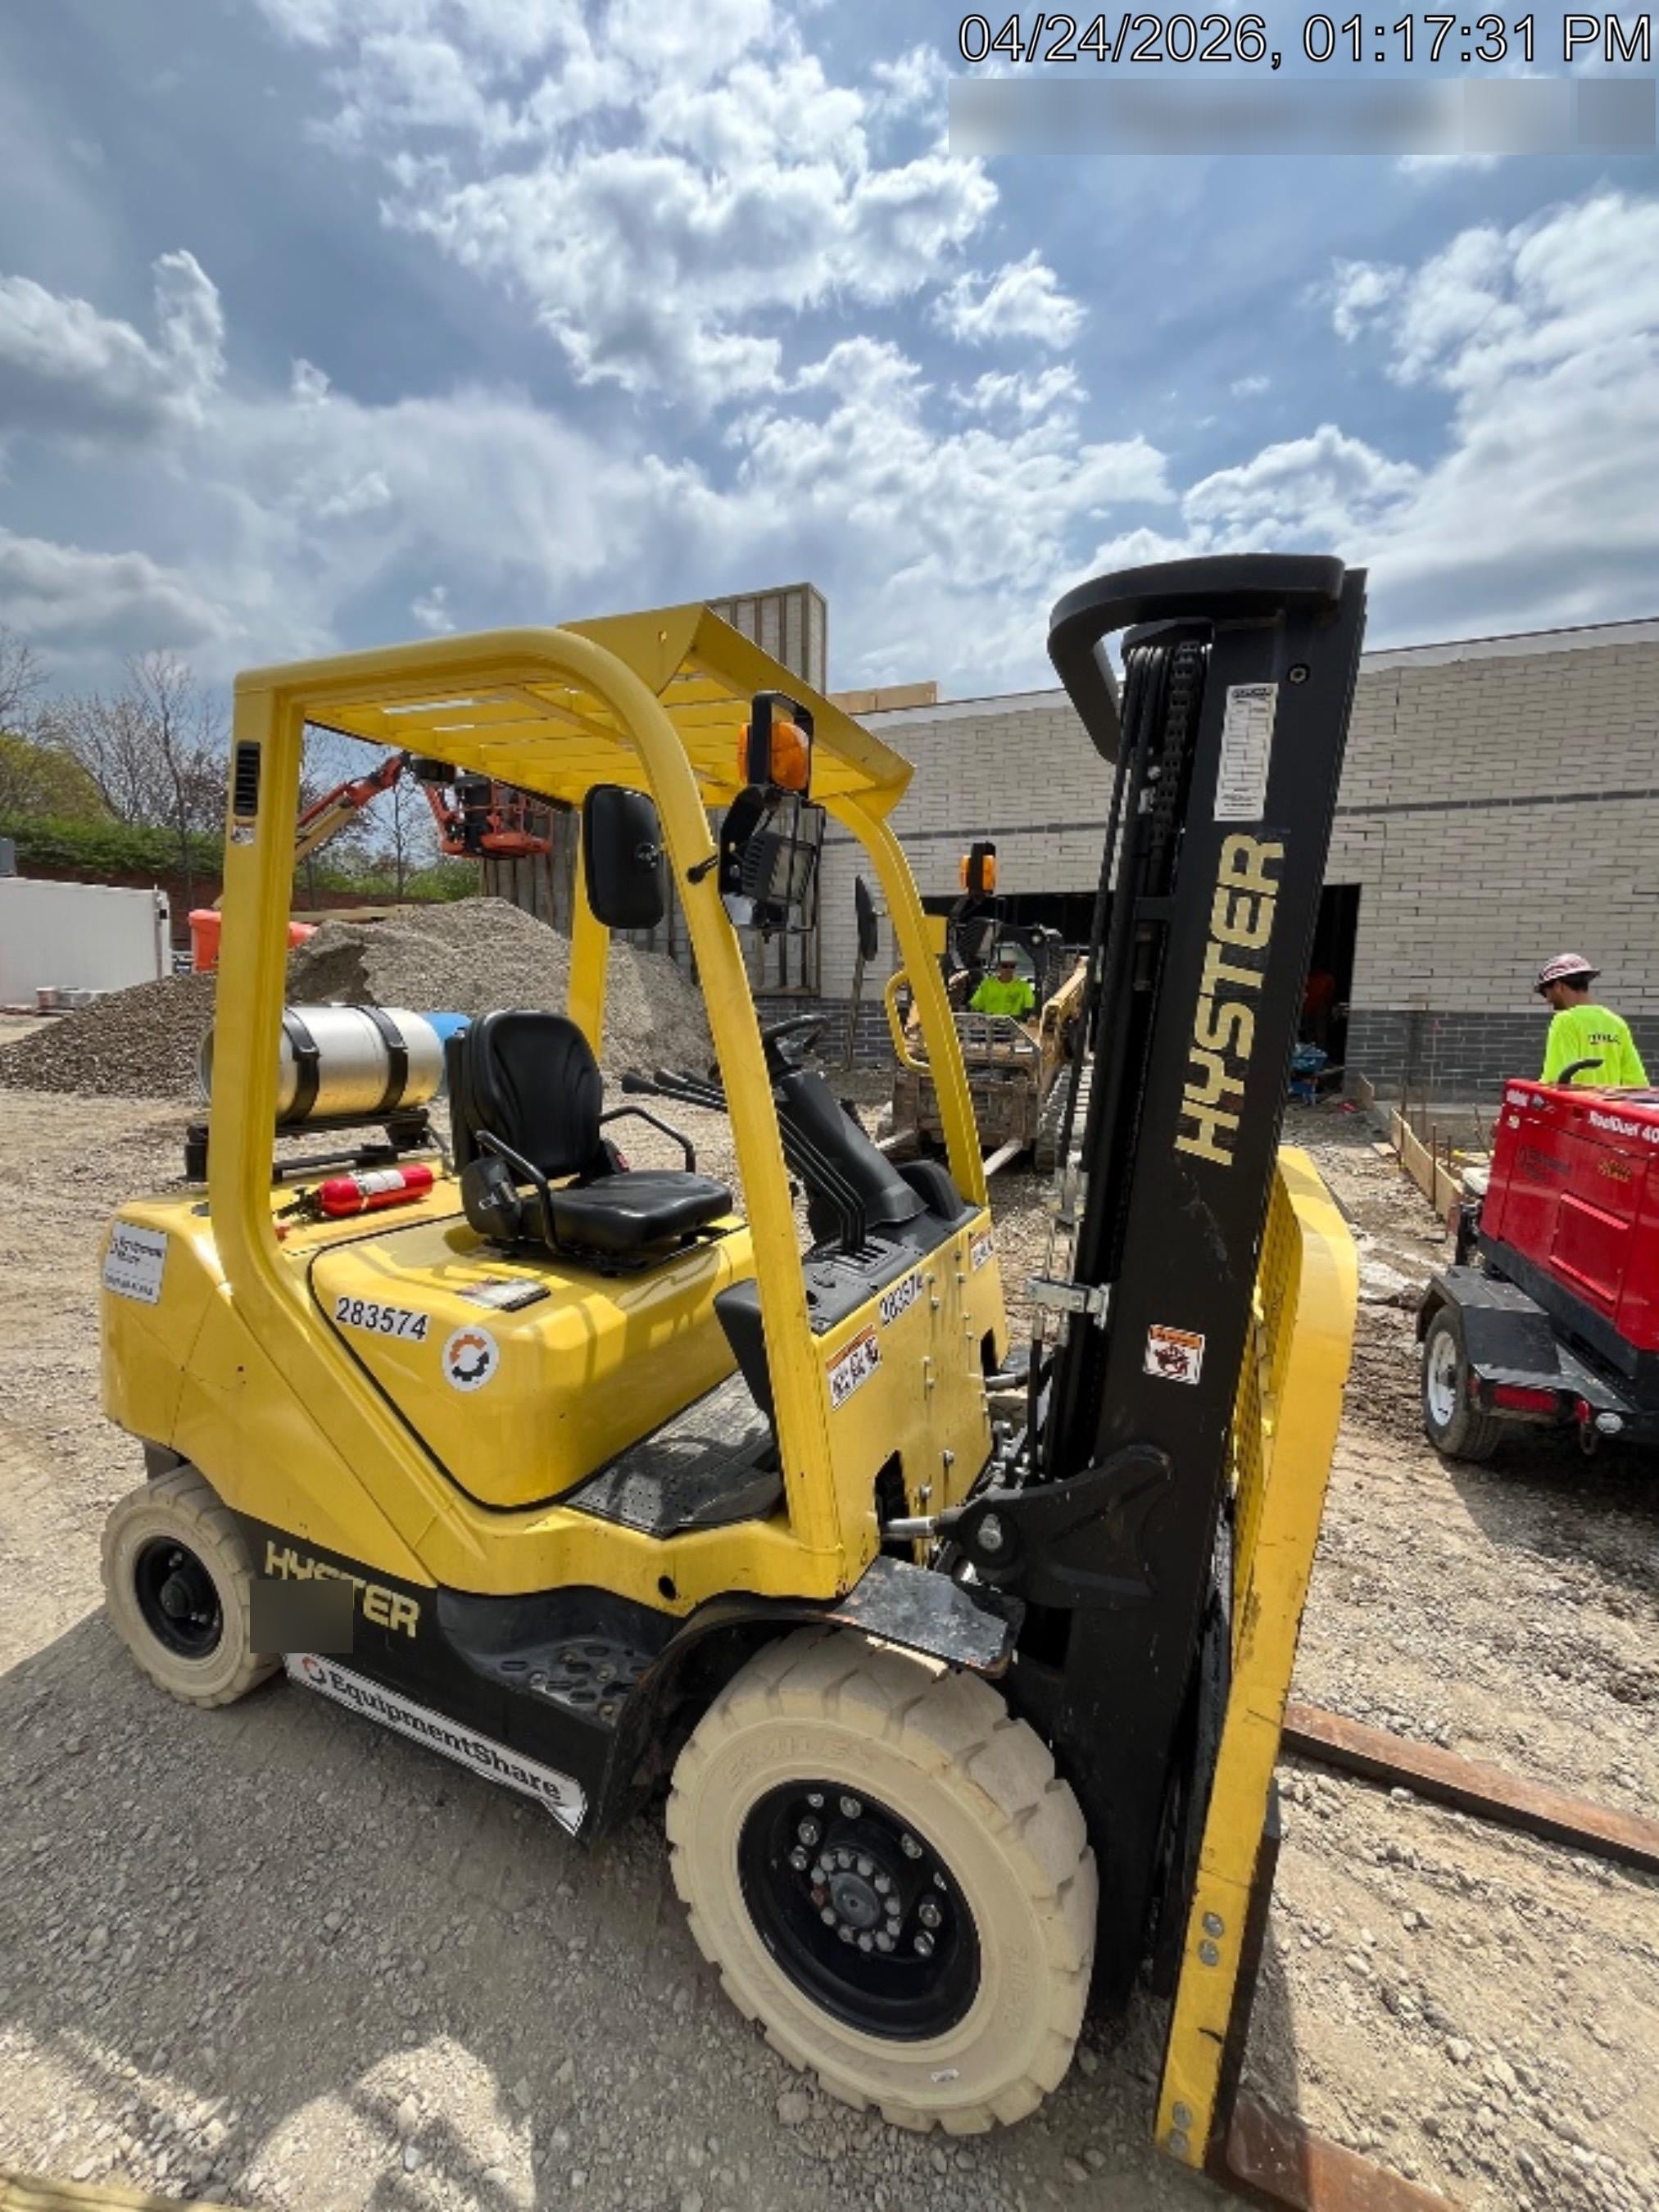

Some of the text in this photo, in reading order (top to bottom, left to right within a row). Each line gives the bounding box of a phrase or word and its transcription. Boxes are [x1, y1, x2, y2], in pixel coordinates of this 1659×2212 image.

[1175, 833, 1285, 1166] HYSTER
[336, 1297, 428, 1340] 283574
[328, 1670, 563, 1801] EquipmentShare
